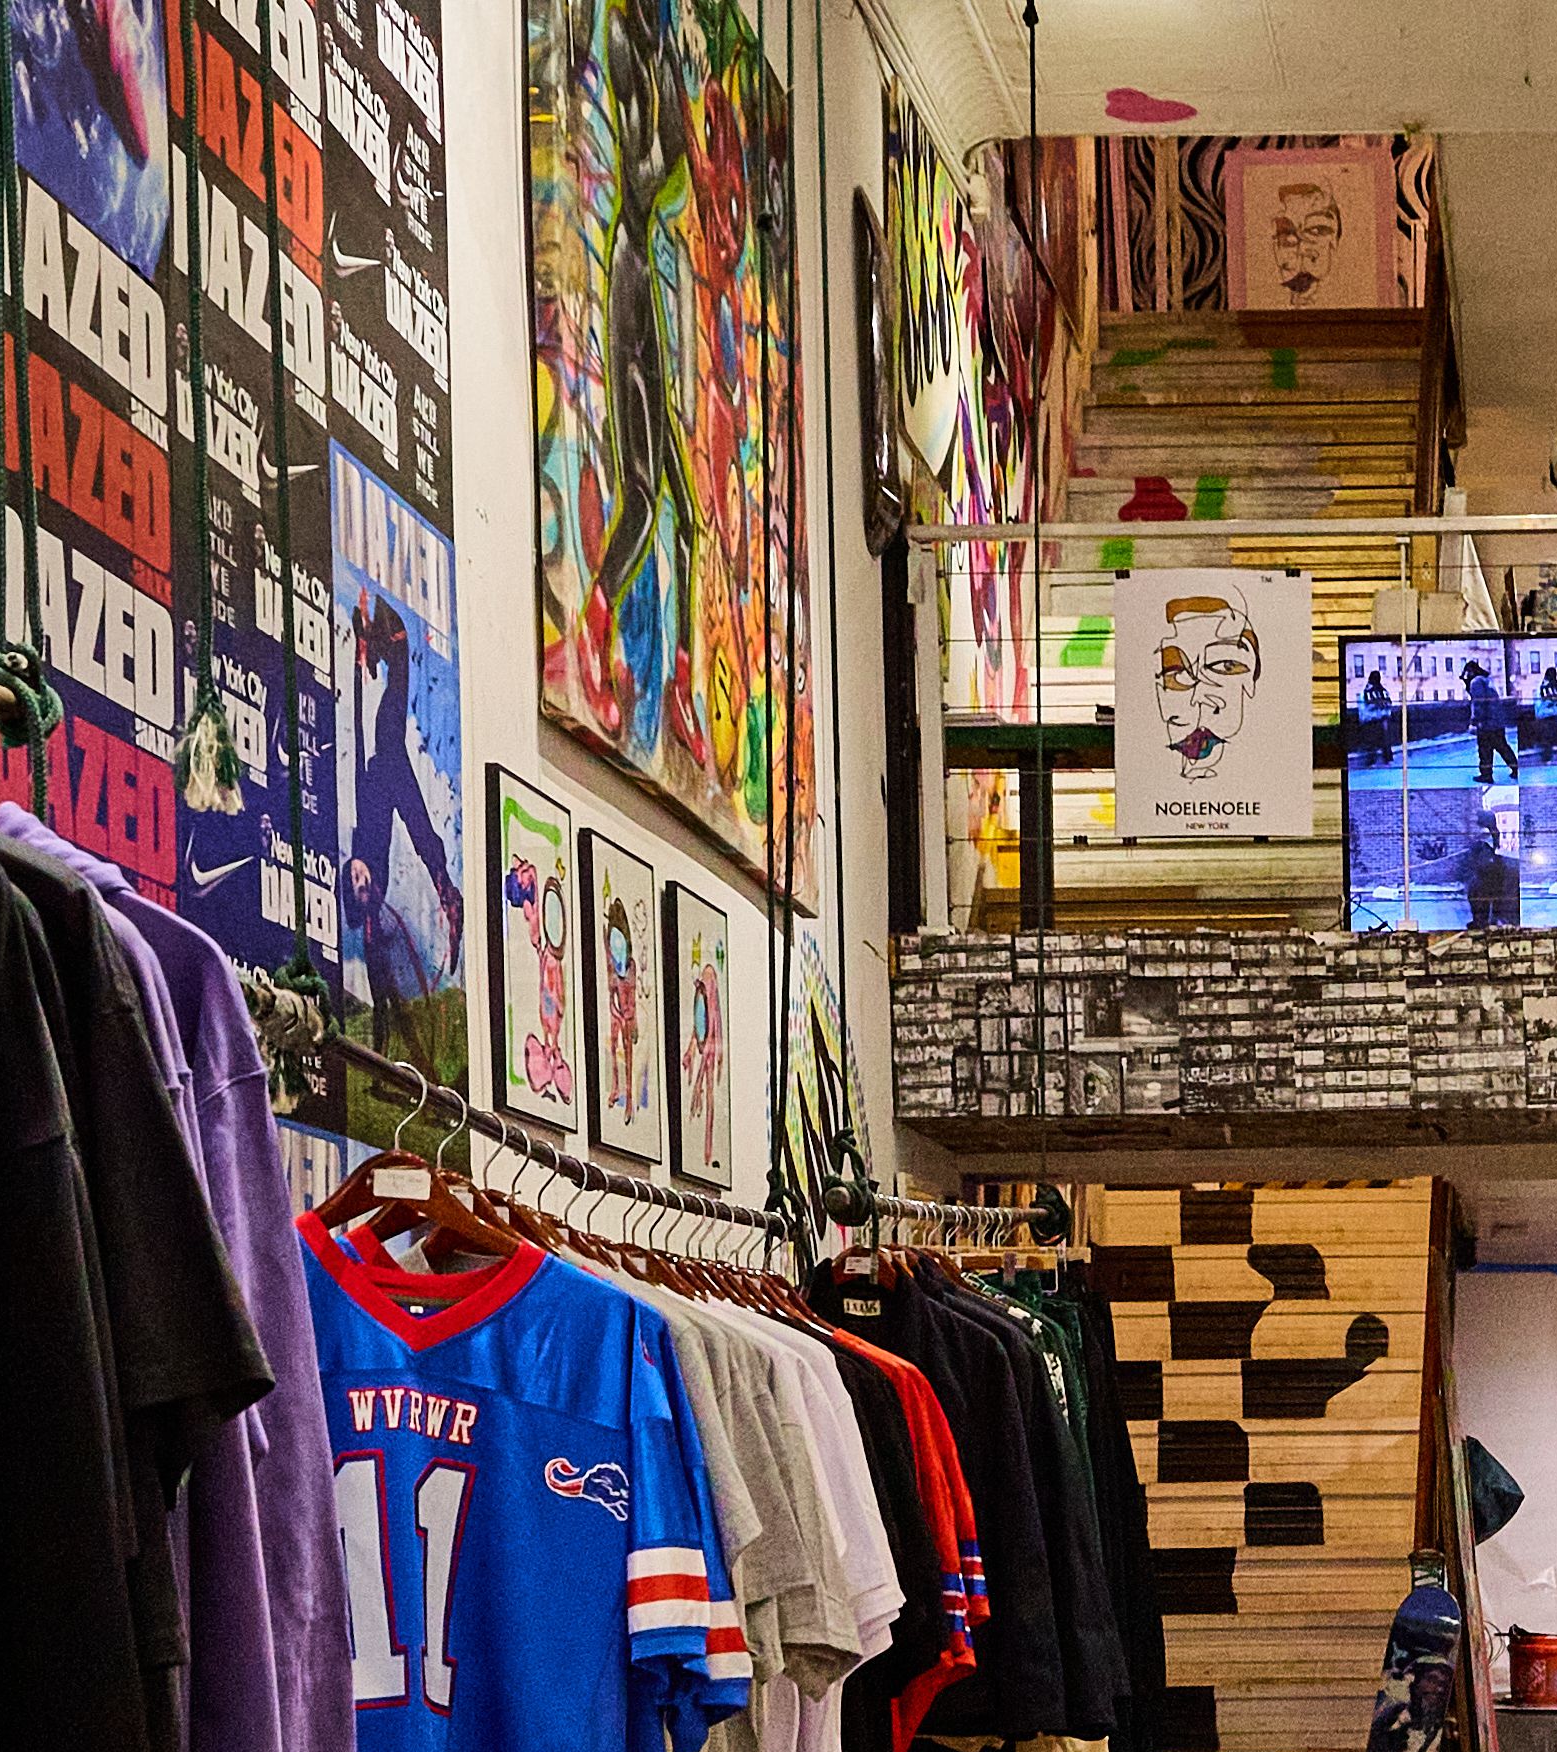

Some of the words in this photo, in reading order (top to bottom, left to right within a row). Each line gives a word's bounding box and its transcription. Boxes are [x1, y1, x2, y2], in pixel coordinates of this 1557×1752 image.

[376, 3, 441, 131] DAZED
[325, 63, 391, 192] DAZED
[408, 210, 433, 252] RIDE
[172, 143, 325, 398] DAZED
[342, 319, 362, 362] New
[385, 266, 448, 380] DAZED
[331, 341, 399, 456] DAZED
[412, 417, 440, 457] STILL
[209, 532, 237, 567] TILL
[335, 452, 451, 632] DAZED
[212, 598, 236, 628] IDE
[223, 654, 246, 697] York
[246, 672, 267, 709] City
[1155, 801, 1261, 817] NOELENOELE
[1185, 821, 1205, 831] NEW
[1207, 821, 1230, 831] YORK
[271, 832, 292, 868] New
[318, 852, 336, 892] City
[349, 1389, 477, 1446] WVRWR
[334, 1450, 477, 1717] 11
